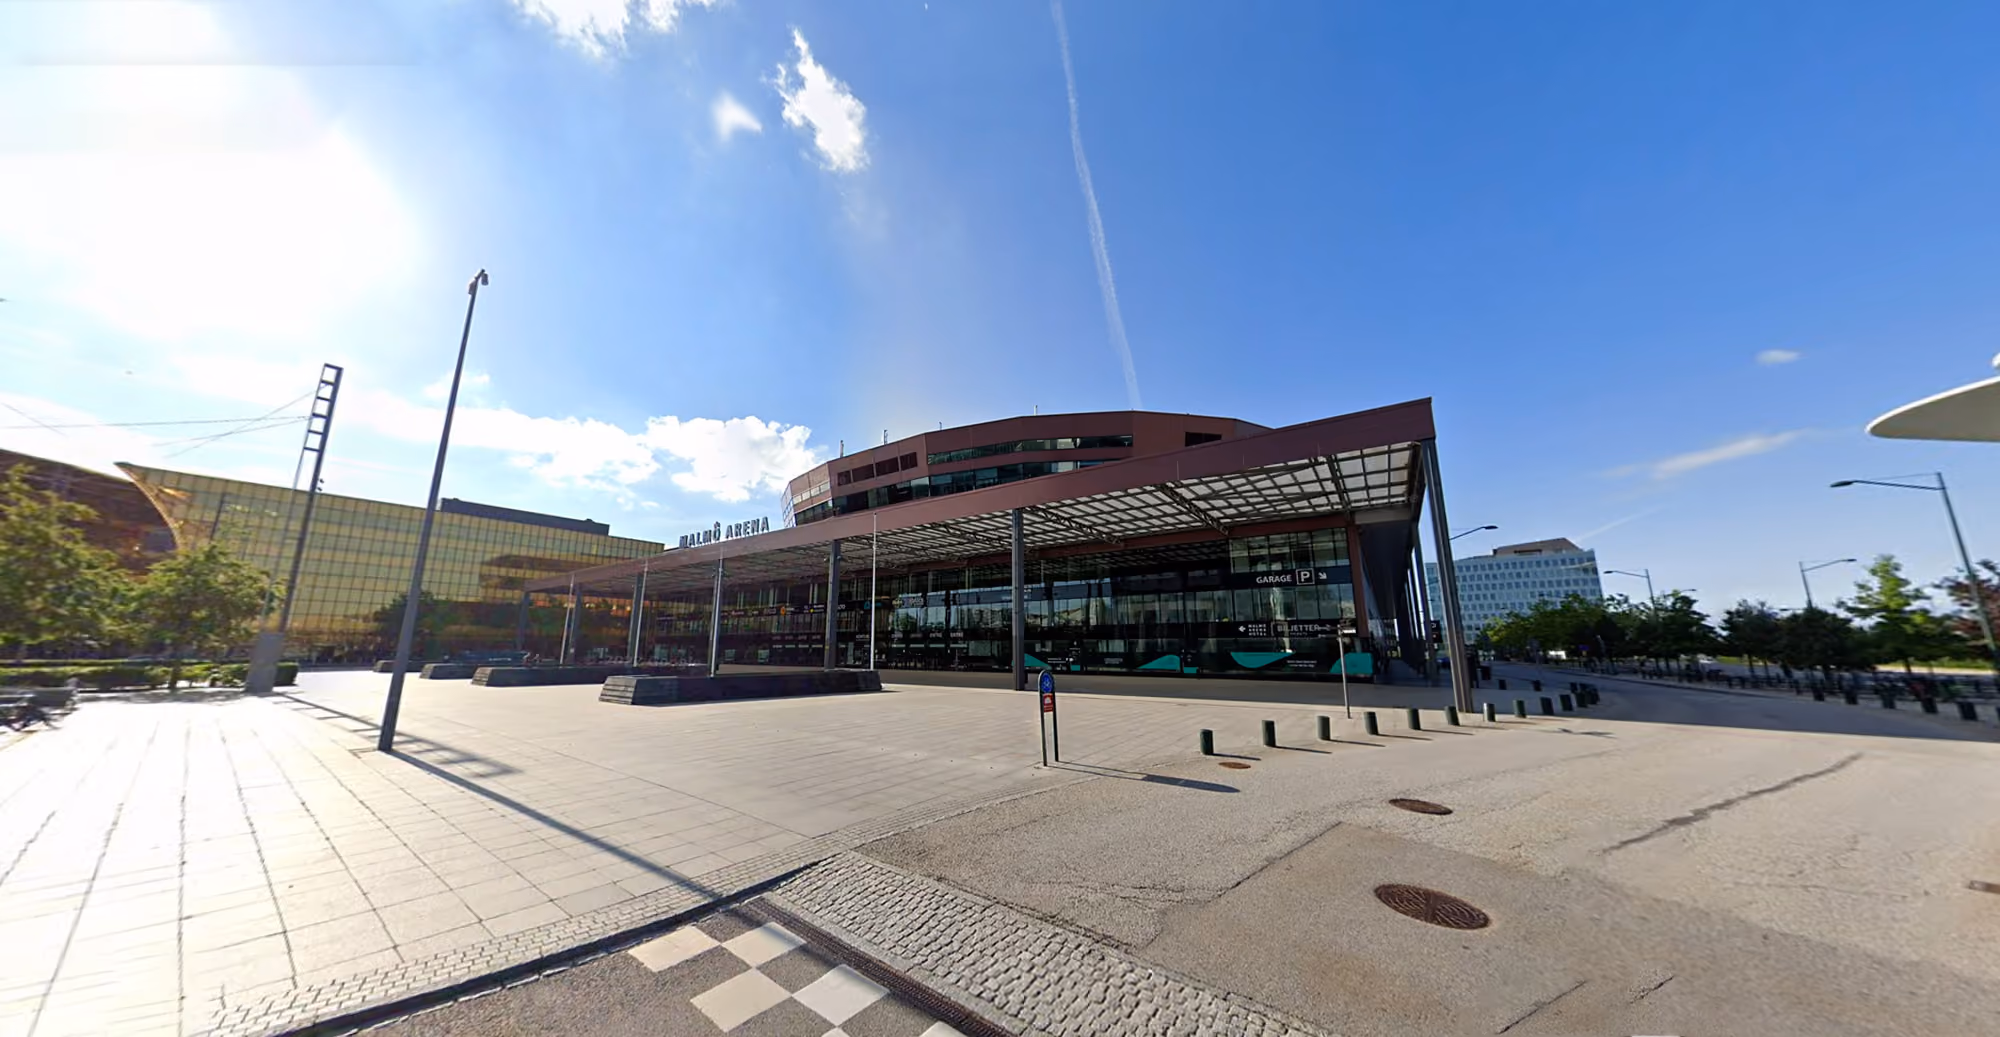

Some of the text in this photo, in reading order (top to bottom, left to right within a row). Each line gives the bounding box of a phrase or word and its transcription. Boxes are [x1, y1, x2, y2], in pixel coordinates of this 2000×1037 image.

[679, 516, 770, 548] MALMÖ ARENA
[1256, 575, 1292, 583] GARAGE
